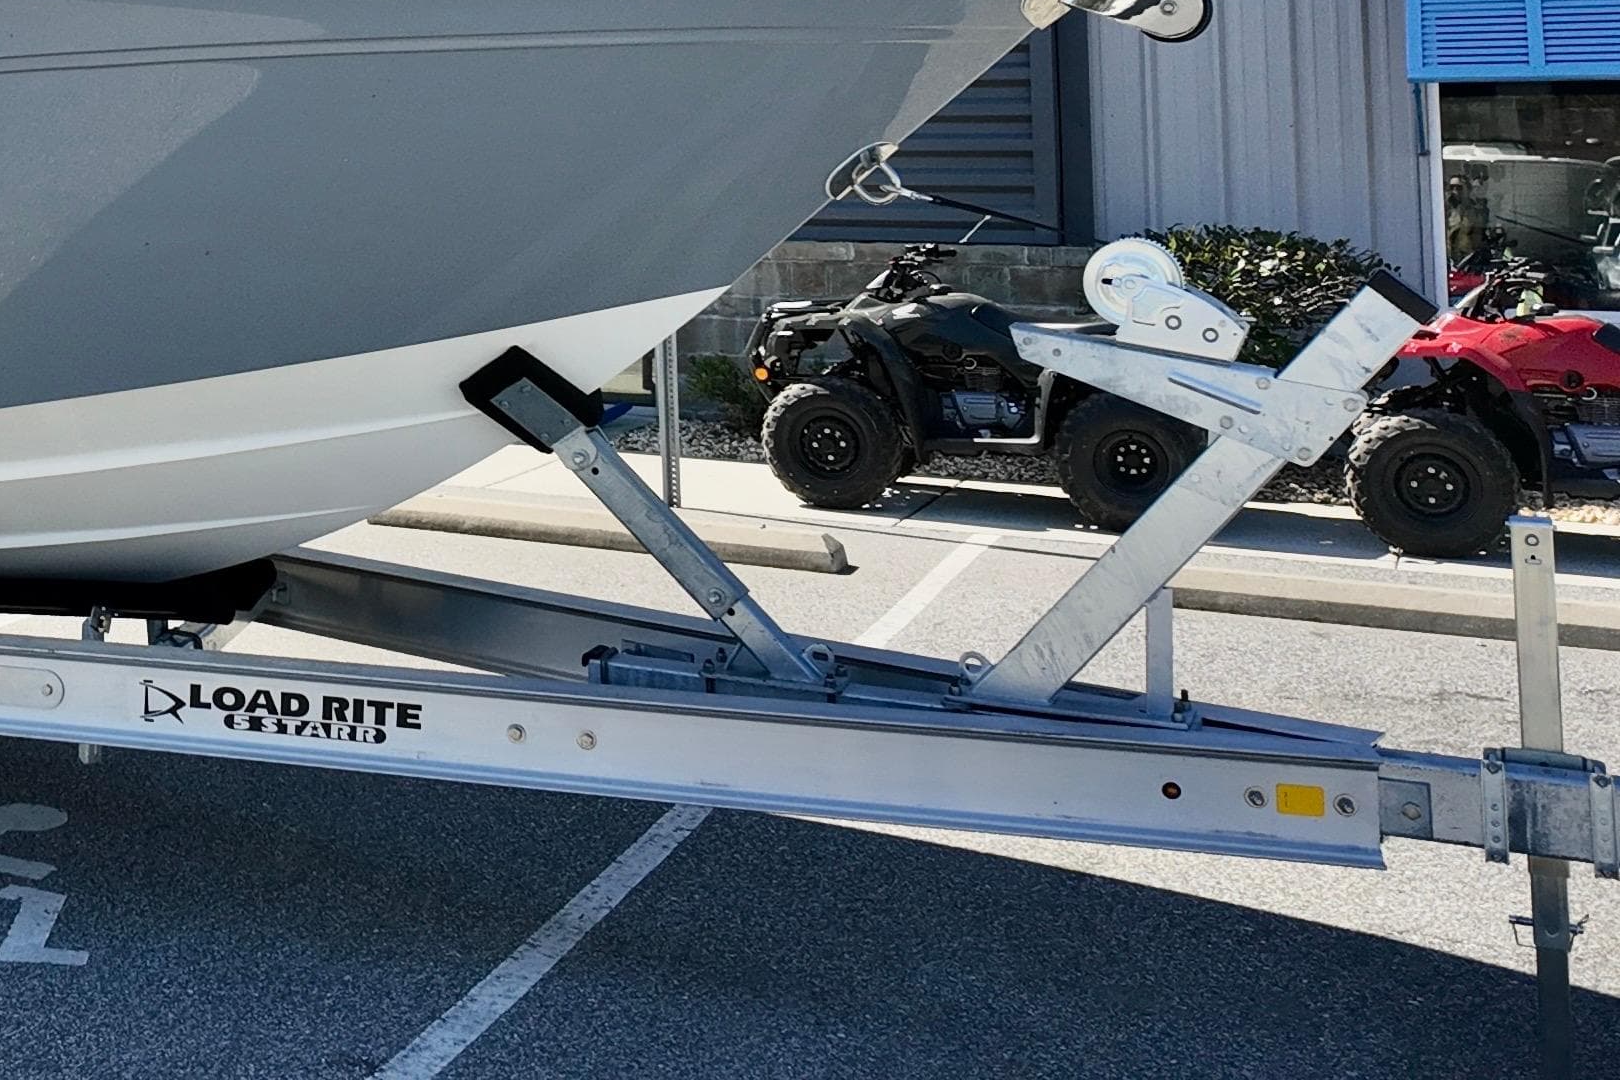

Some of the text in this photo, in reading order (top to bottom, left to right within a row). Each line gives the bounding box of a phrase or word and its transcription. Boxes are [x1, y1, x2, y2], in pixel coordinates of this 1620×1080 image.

[189, 683, 423, 730] LOAD RITE
[233, 713, 379, 744] 5 STARR
